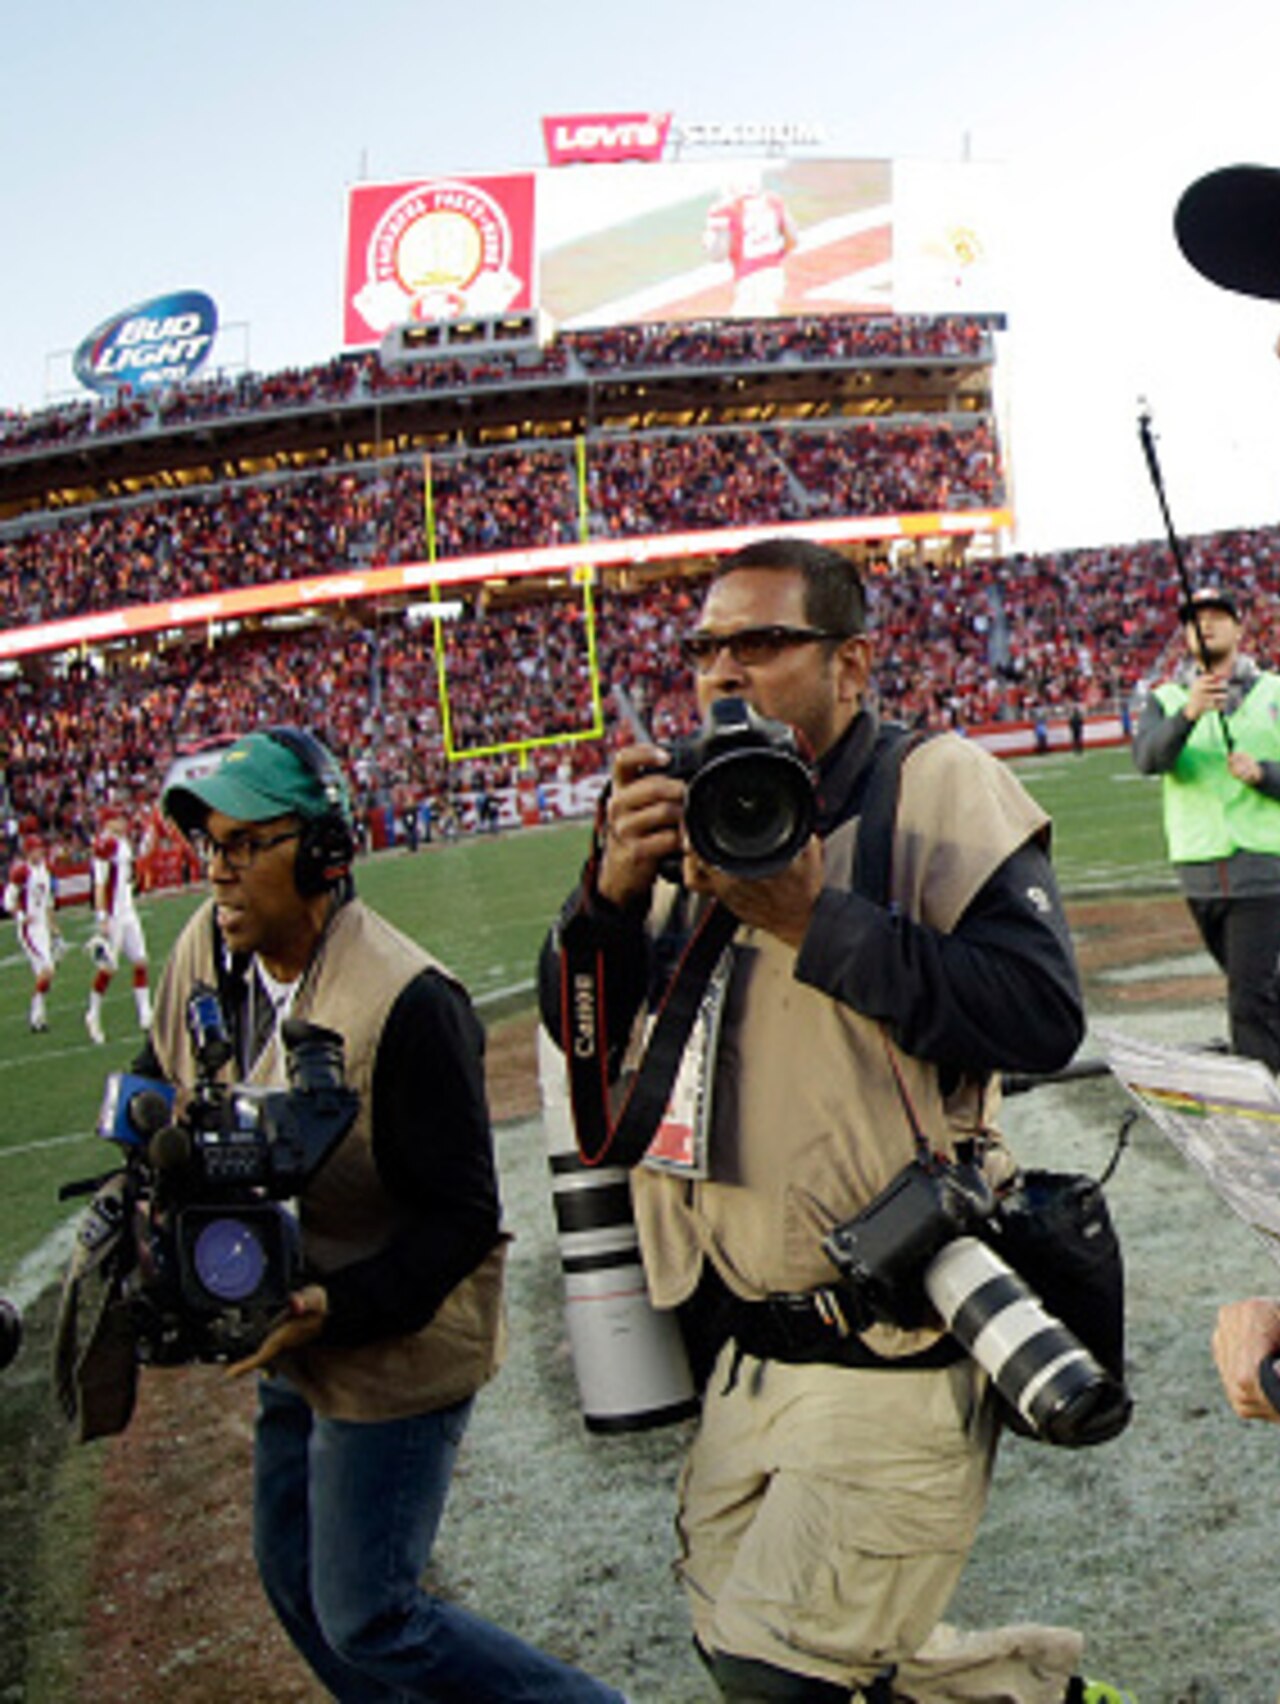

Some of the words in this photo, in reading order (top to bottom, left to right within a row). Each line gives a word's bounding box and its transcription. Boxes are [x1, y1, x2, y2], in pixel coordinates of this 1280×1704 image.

[115, 312, 200, 346] BUD
[95, 334, 211, 374] LIGHT
[573, 972, 595, 1059] Canon
